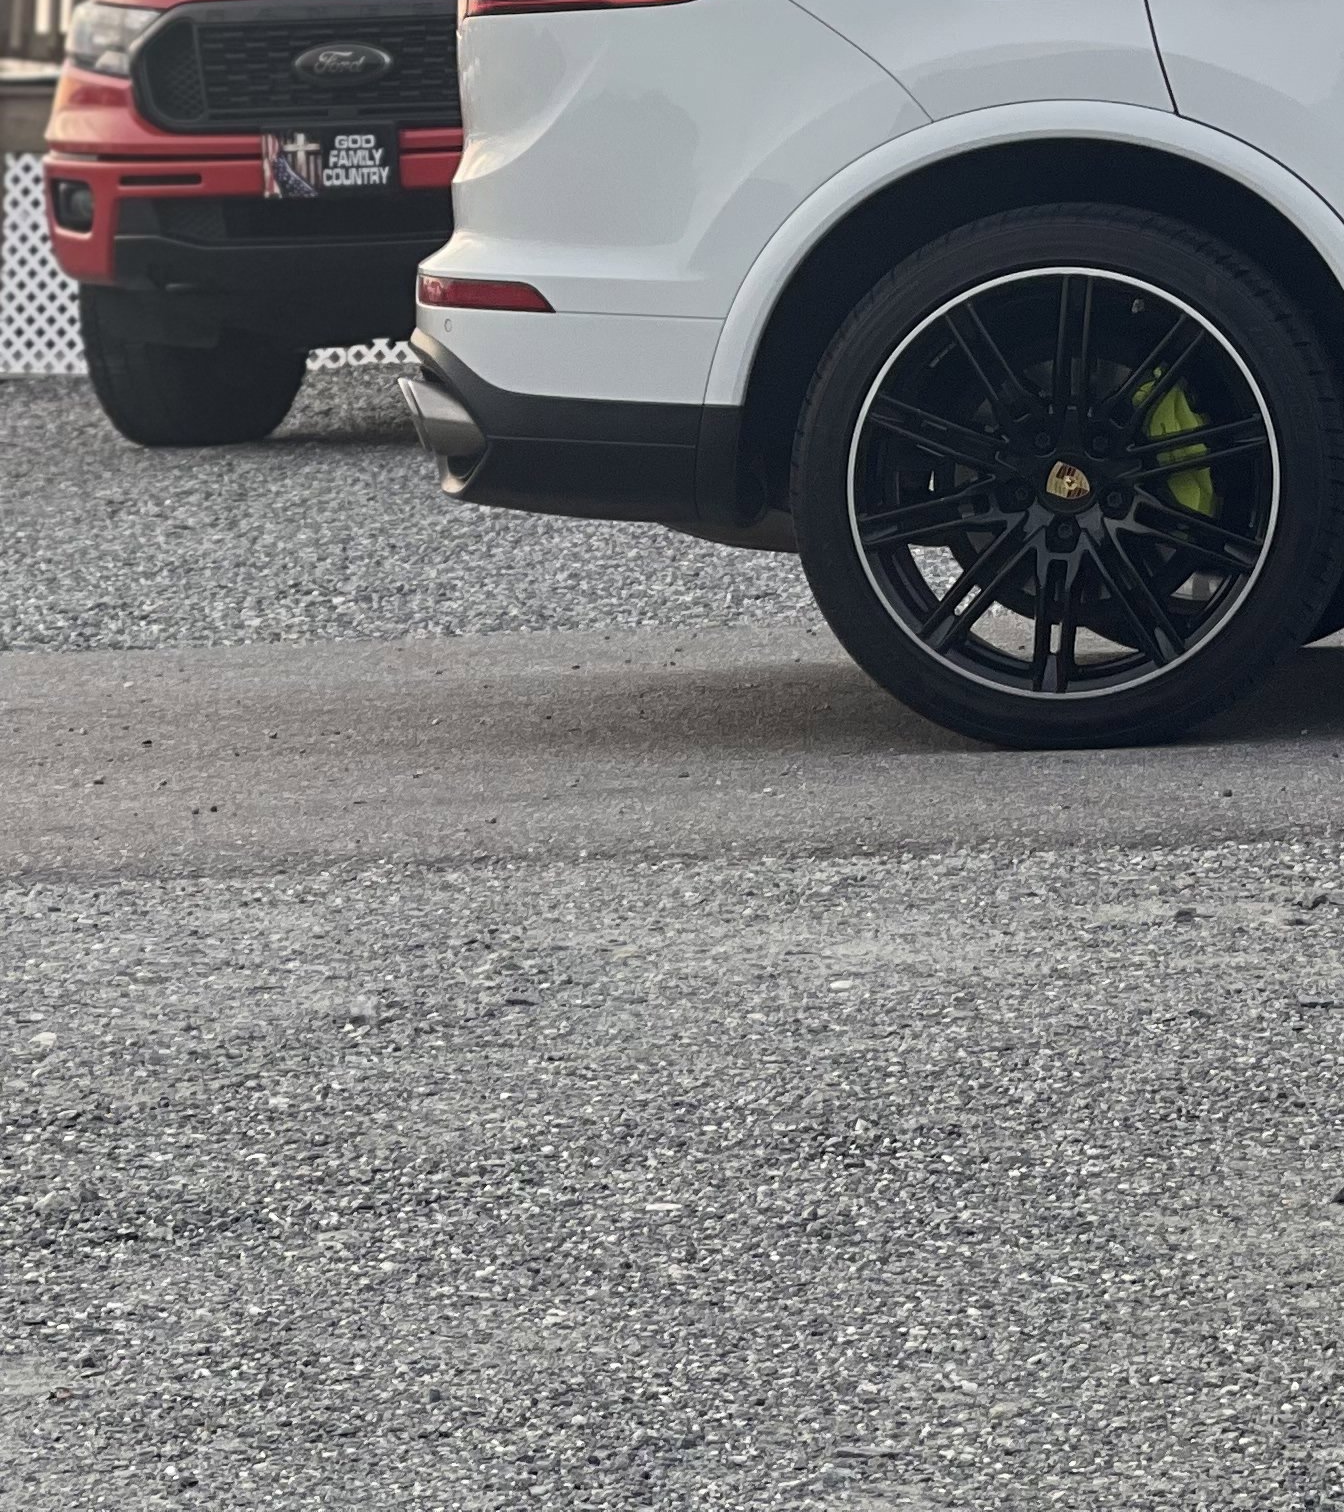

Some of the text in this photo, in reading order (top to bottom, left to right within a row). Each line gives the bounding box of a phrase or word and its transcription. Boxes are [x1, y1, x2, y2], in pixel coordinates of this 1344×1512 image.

[314, 50, 366, 73] Ford
[334, 134, 376, 149] GOD
[328, 148, 384, 167] FAMILY
[322, 166, 390, 186] COUNTRY
